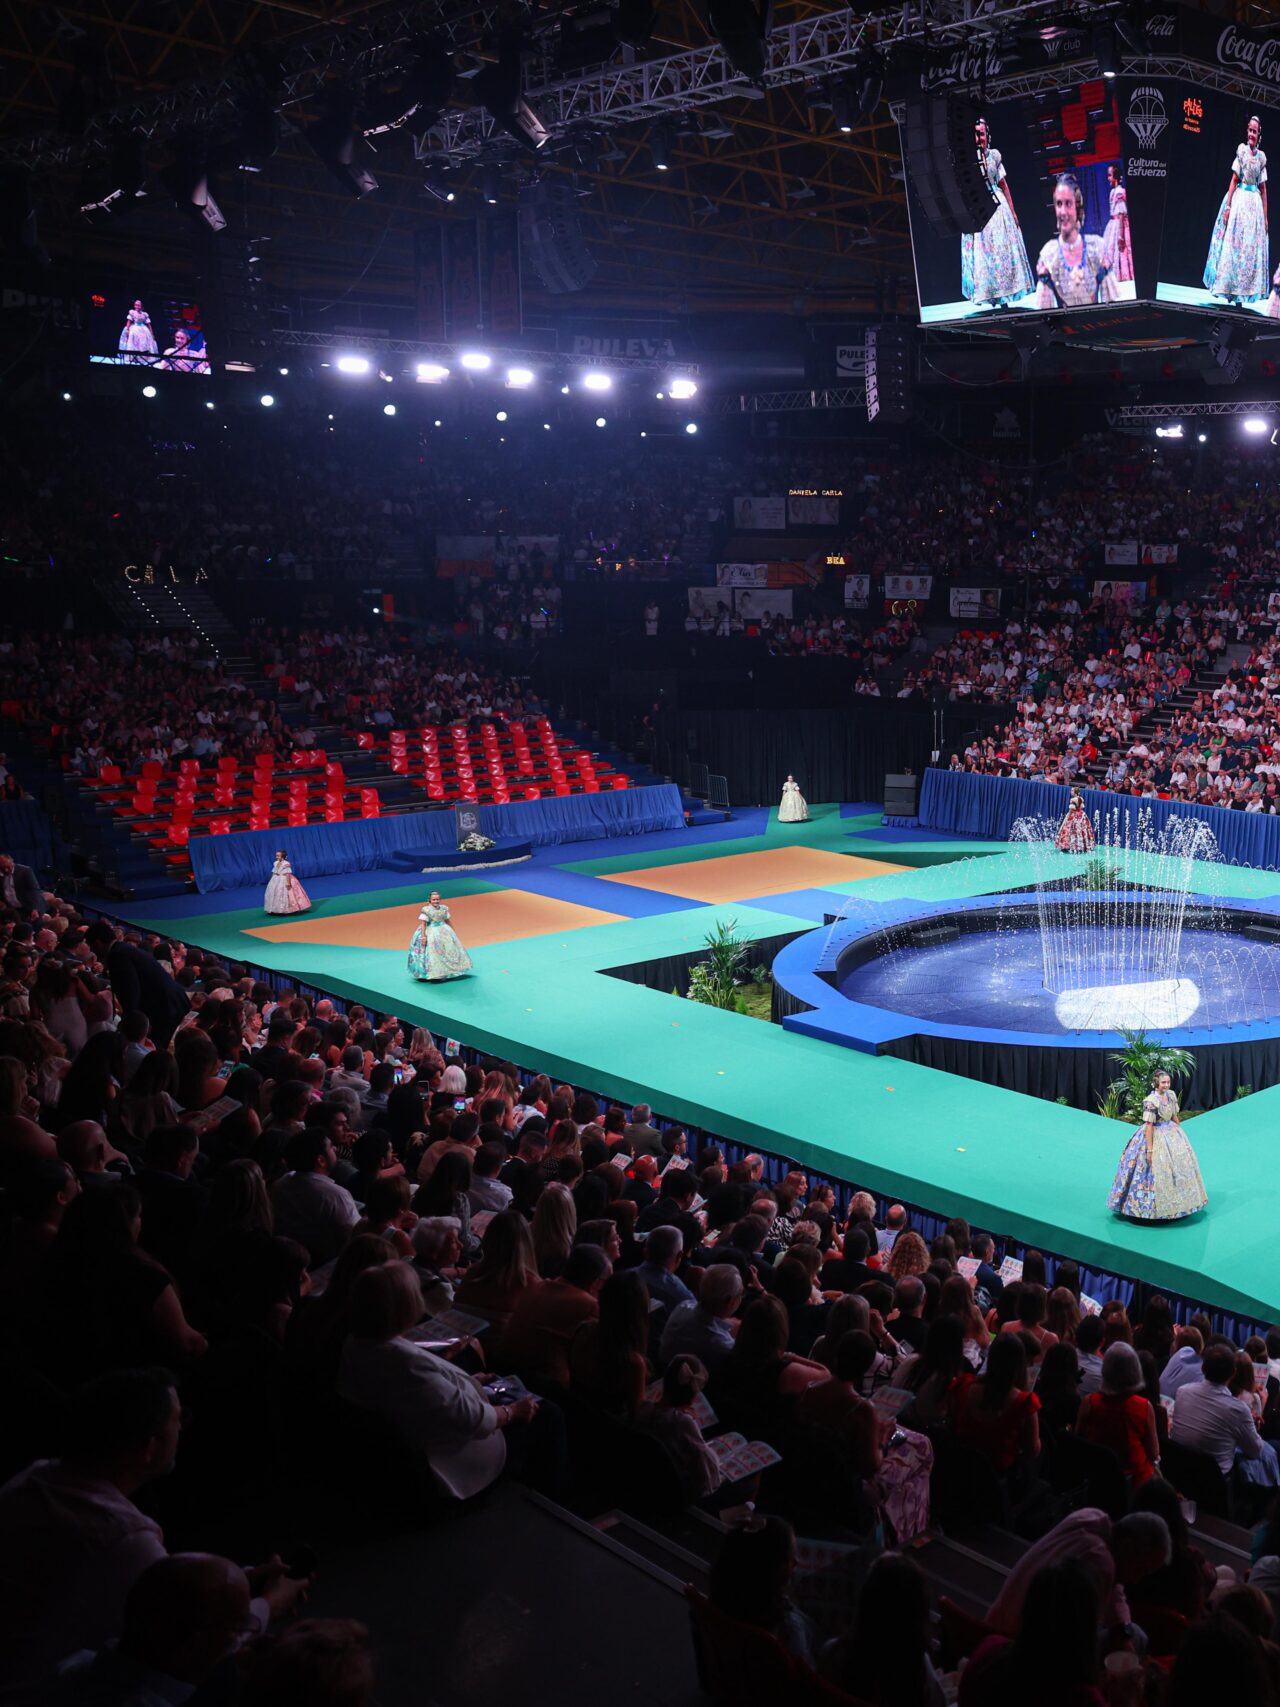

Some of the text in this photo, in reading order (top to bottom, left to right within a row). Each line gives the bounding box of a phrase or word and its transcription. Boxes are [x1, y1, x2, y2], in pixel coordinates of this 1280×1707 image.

[1128, 157, 1159, 167] Cultura
[1127, 166, 1167, 177] Esfuerzo
[573, 333, 676, 358] PULEVA
[839, 348, 866, 360] PULE
